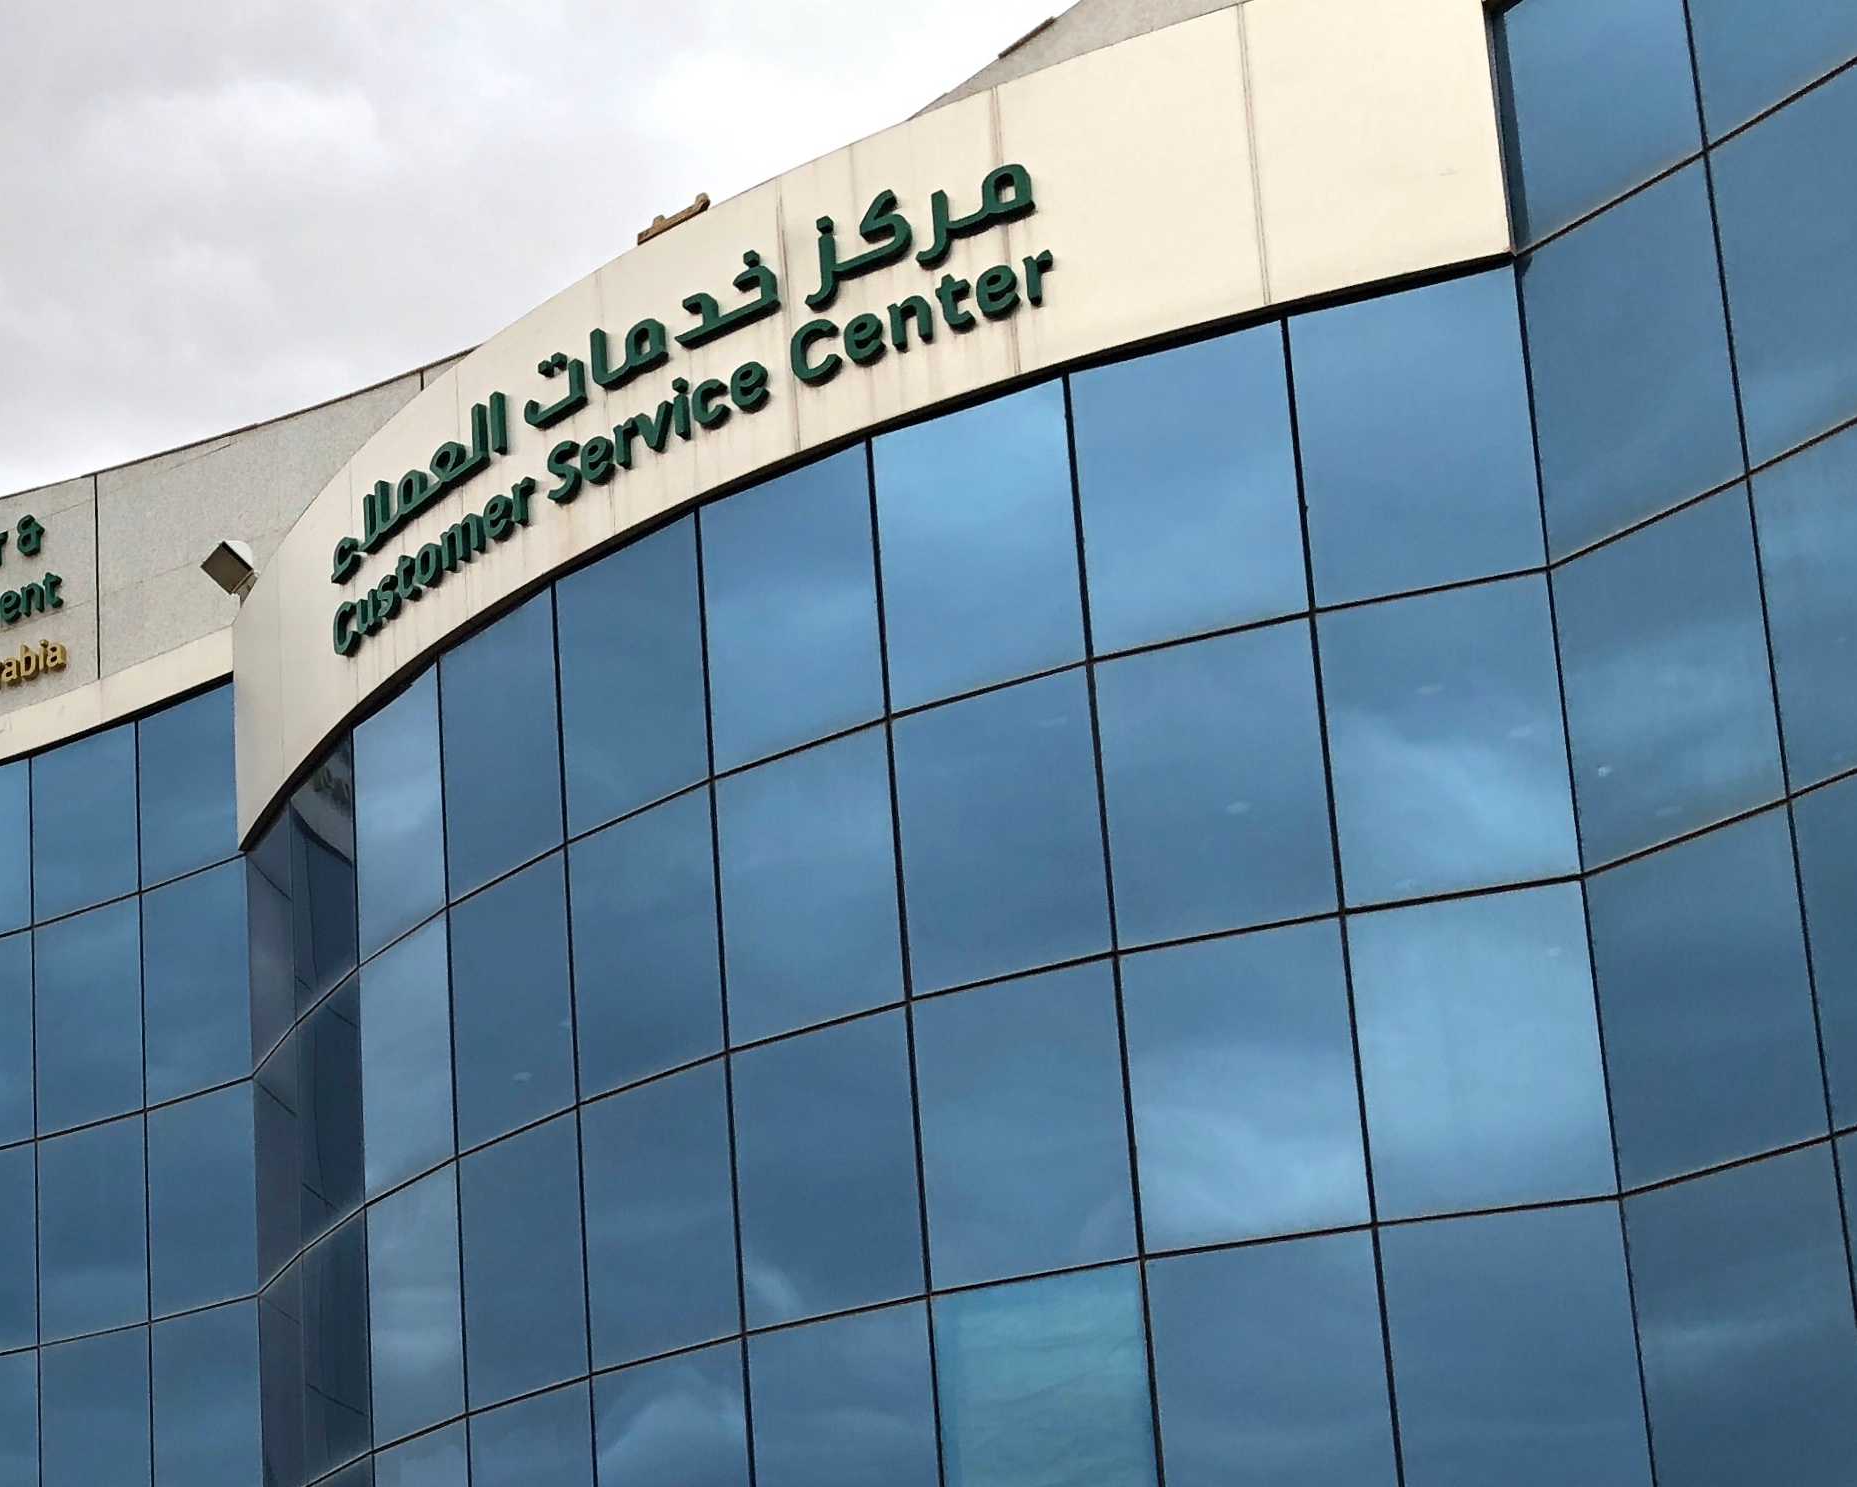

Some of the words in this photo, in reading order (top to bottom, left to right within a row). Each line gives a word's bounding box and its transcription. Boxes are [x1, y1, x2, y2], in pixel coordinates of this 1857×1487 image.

[805, 163, 1037, 310] مركز
[524, 250, 783, 432] خدمات
[16, 513, 45, 557] &
[329, 390, 509, 585] العملاء
[331, 475, 537, 658] Customer
[546, 359, 770, 505] Service
[789, 248, 1054, 386] Center
